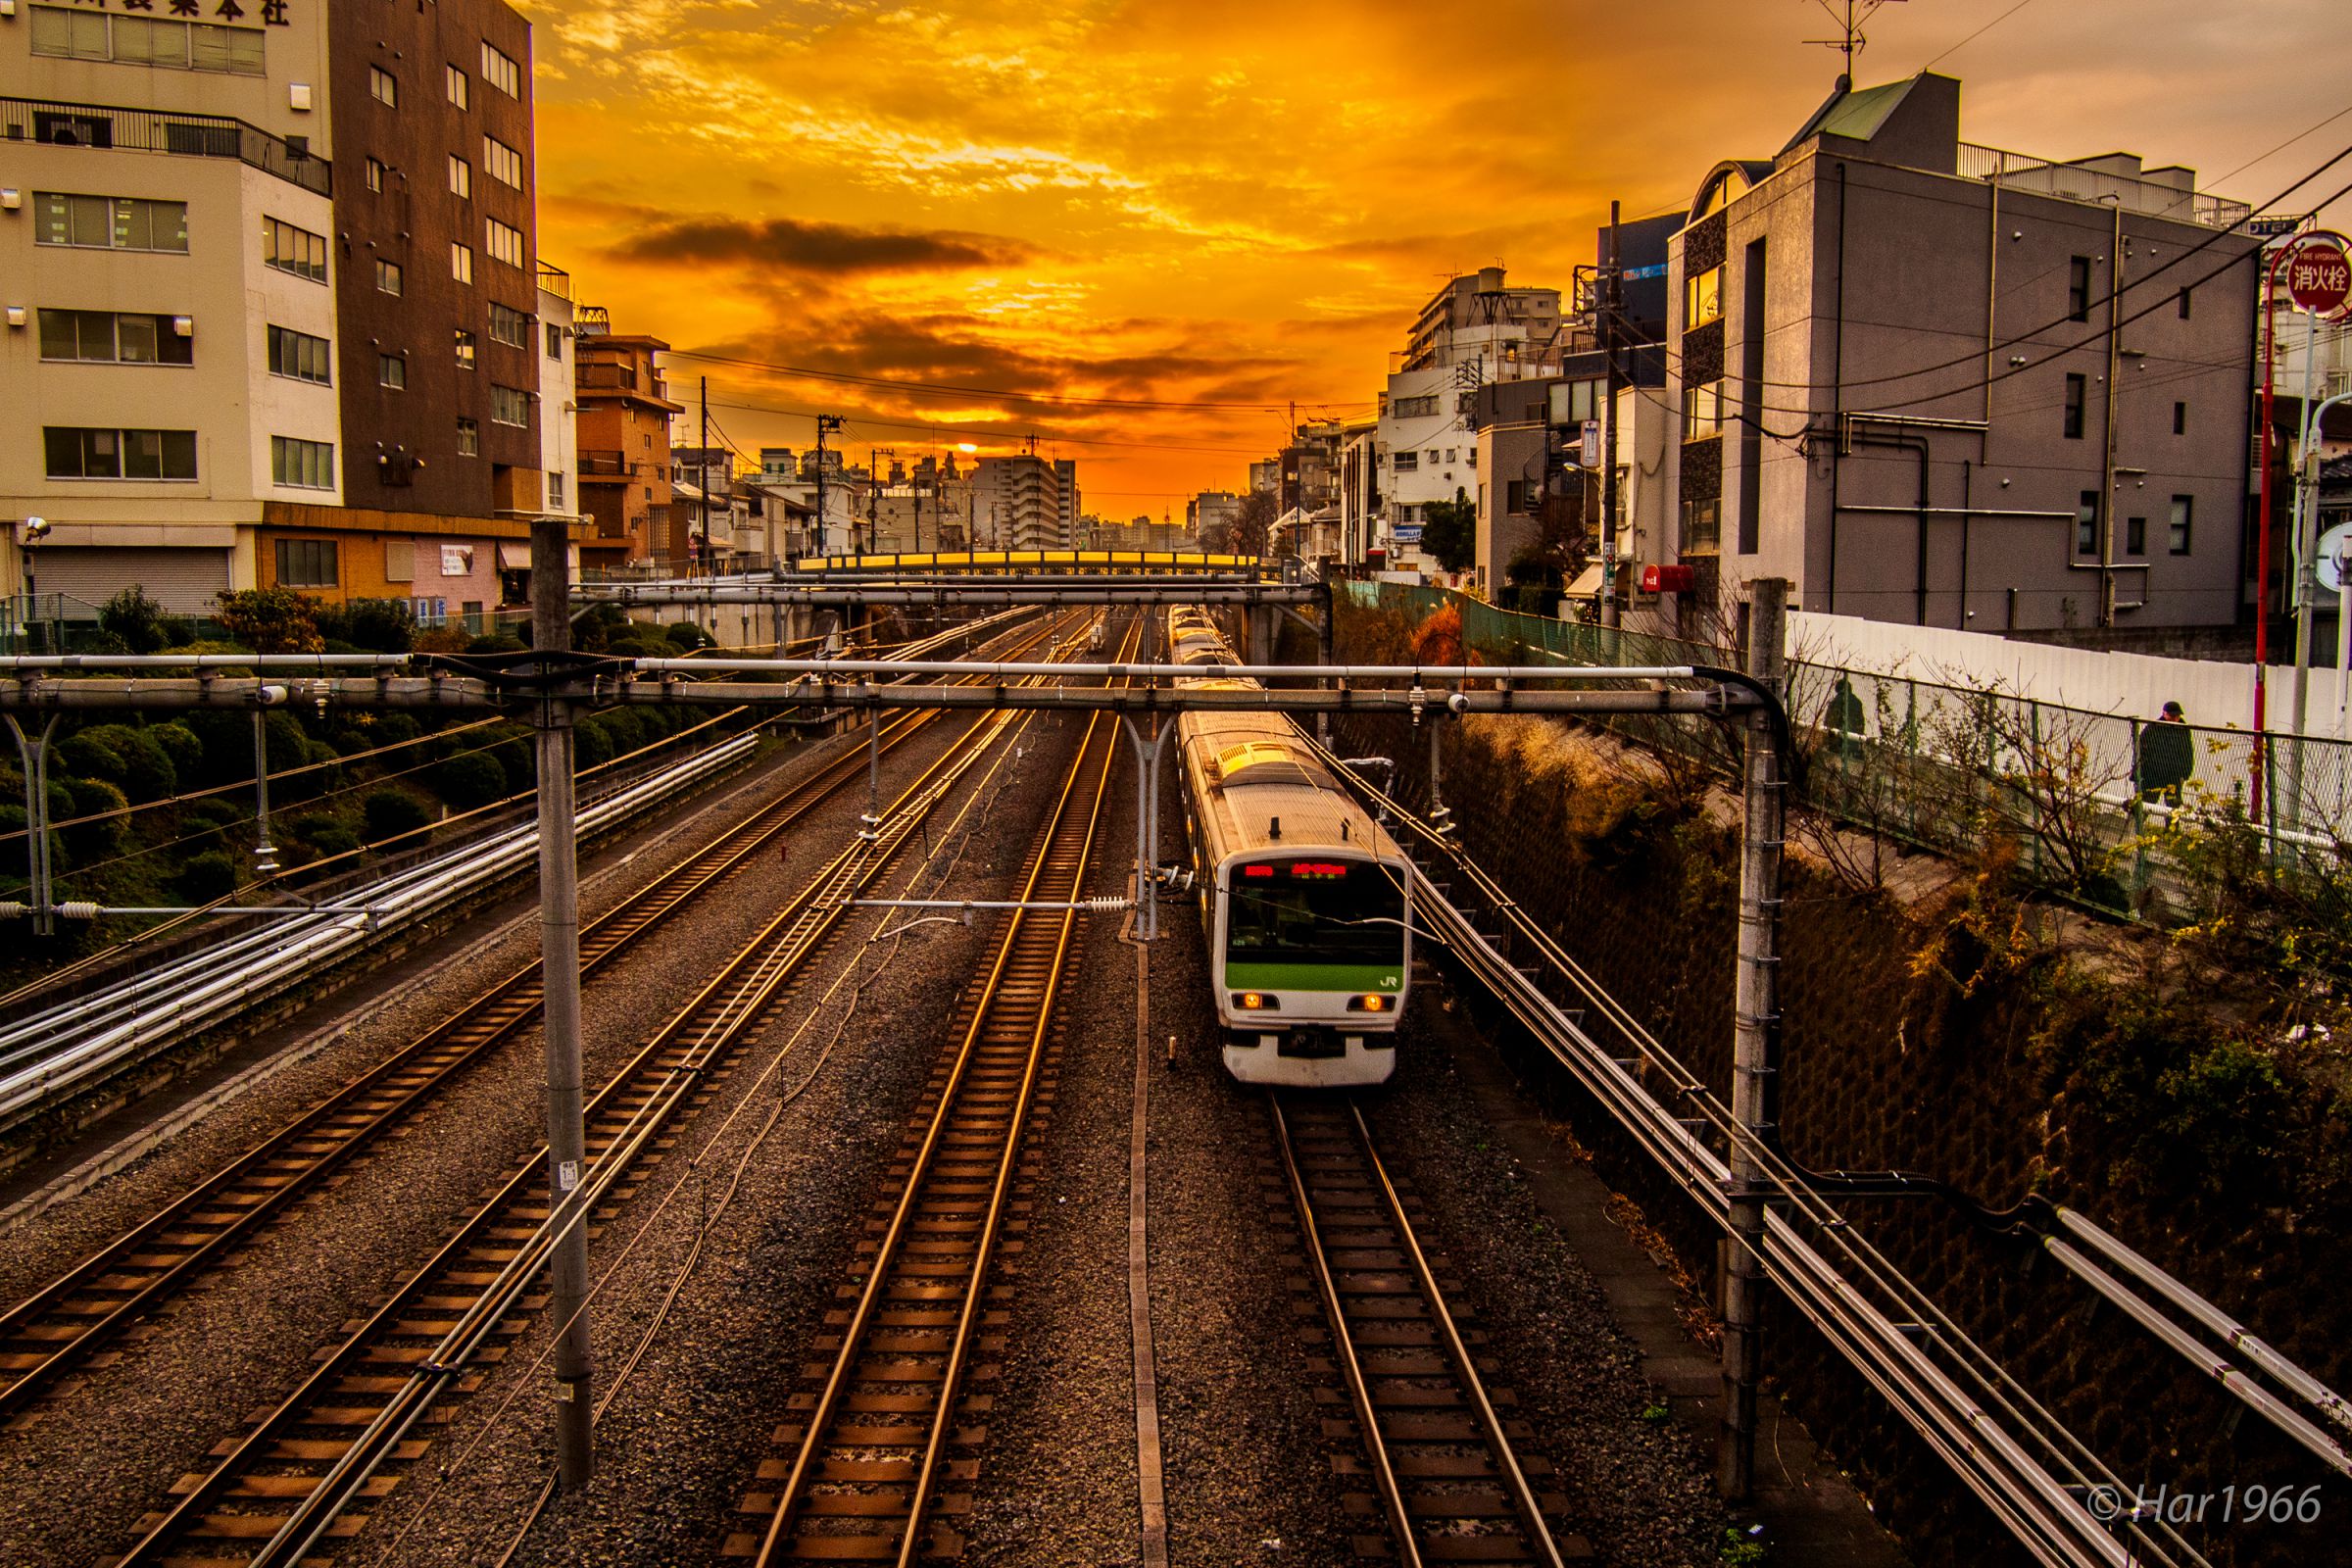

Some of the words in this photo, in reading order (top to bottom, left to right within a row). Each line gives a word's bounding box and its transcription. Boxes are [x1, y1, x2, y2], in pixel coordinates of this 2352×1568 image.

[2250, 221, 2292, 233] OTEL
[2299, 252, 2313, 261] FIRE
[2294, 265, 2347, 291] 消火栓
[1380, 976, 1396, 987] JR
